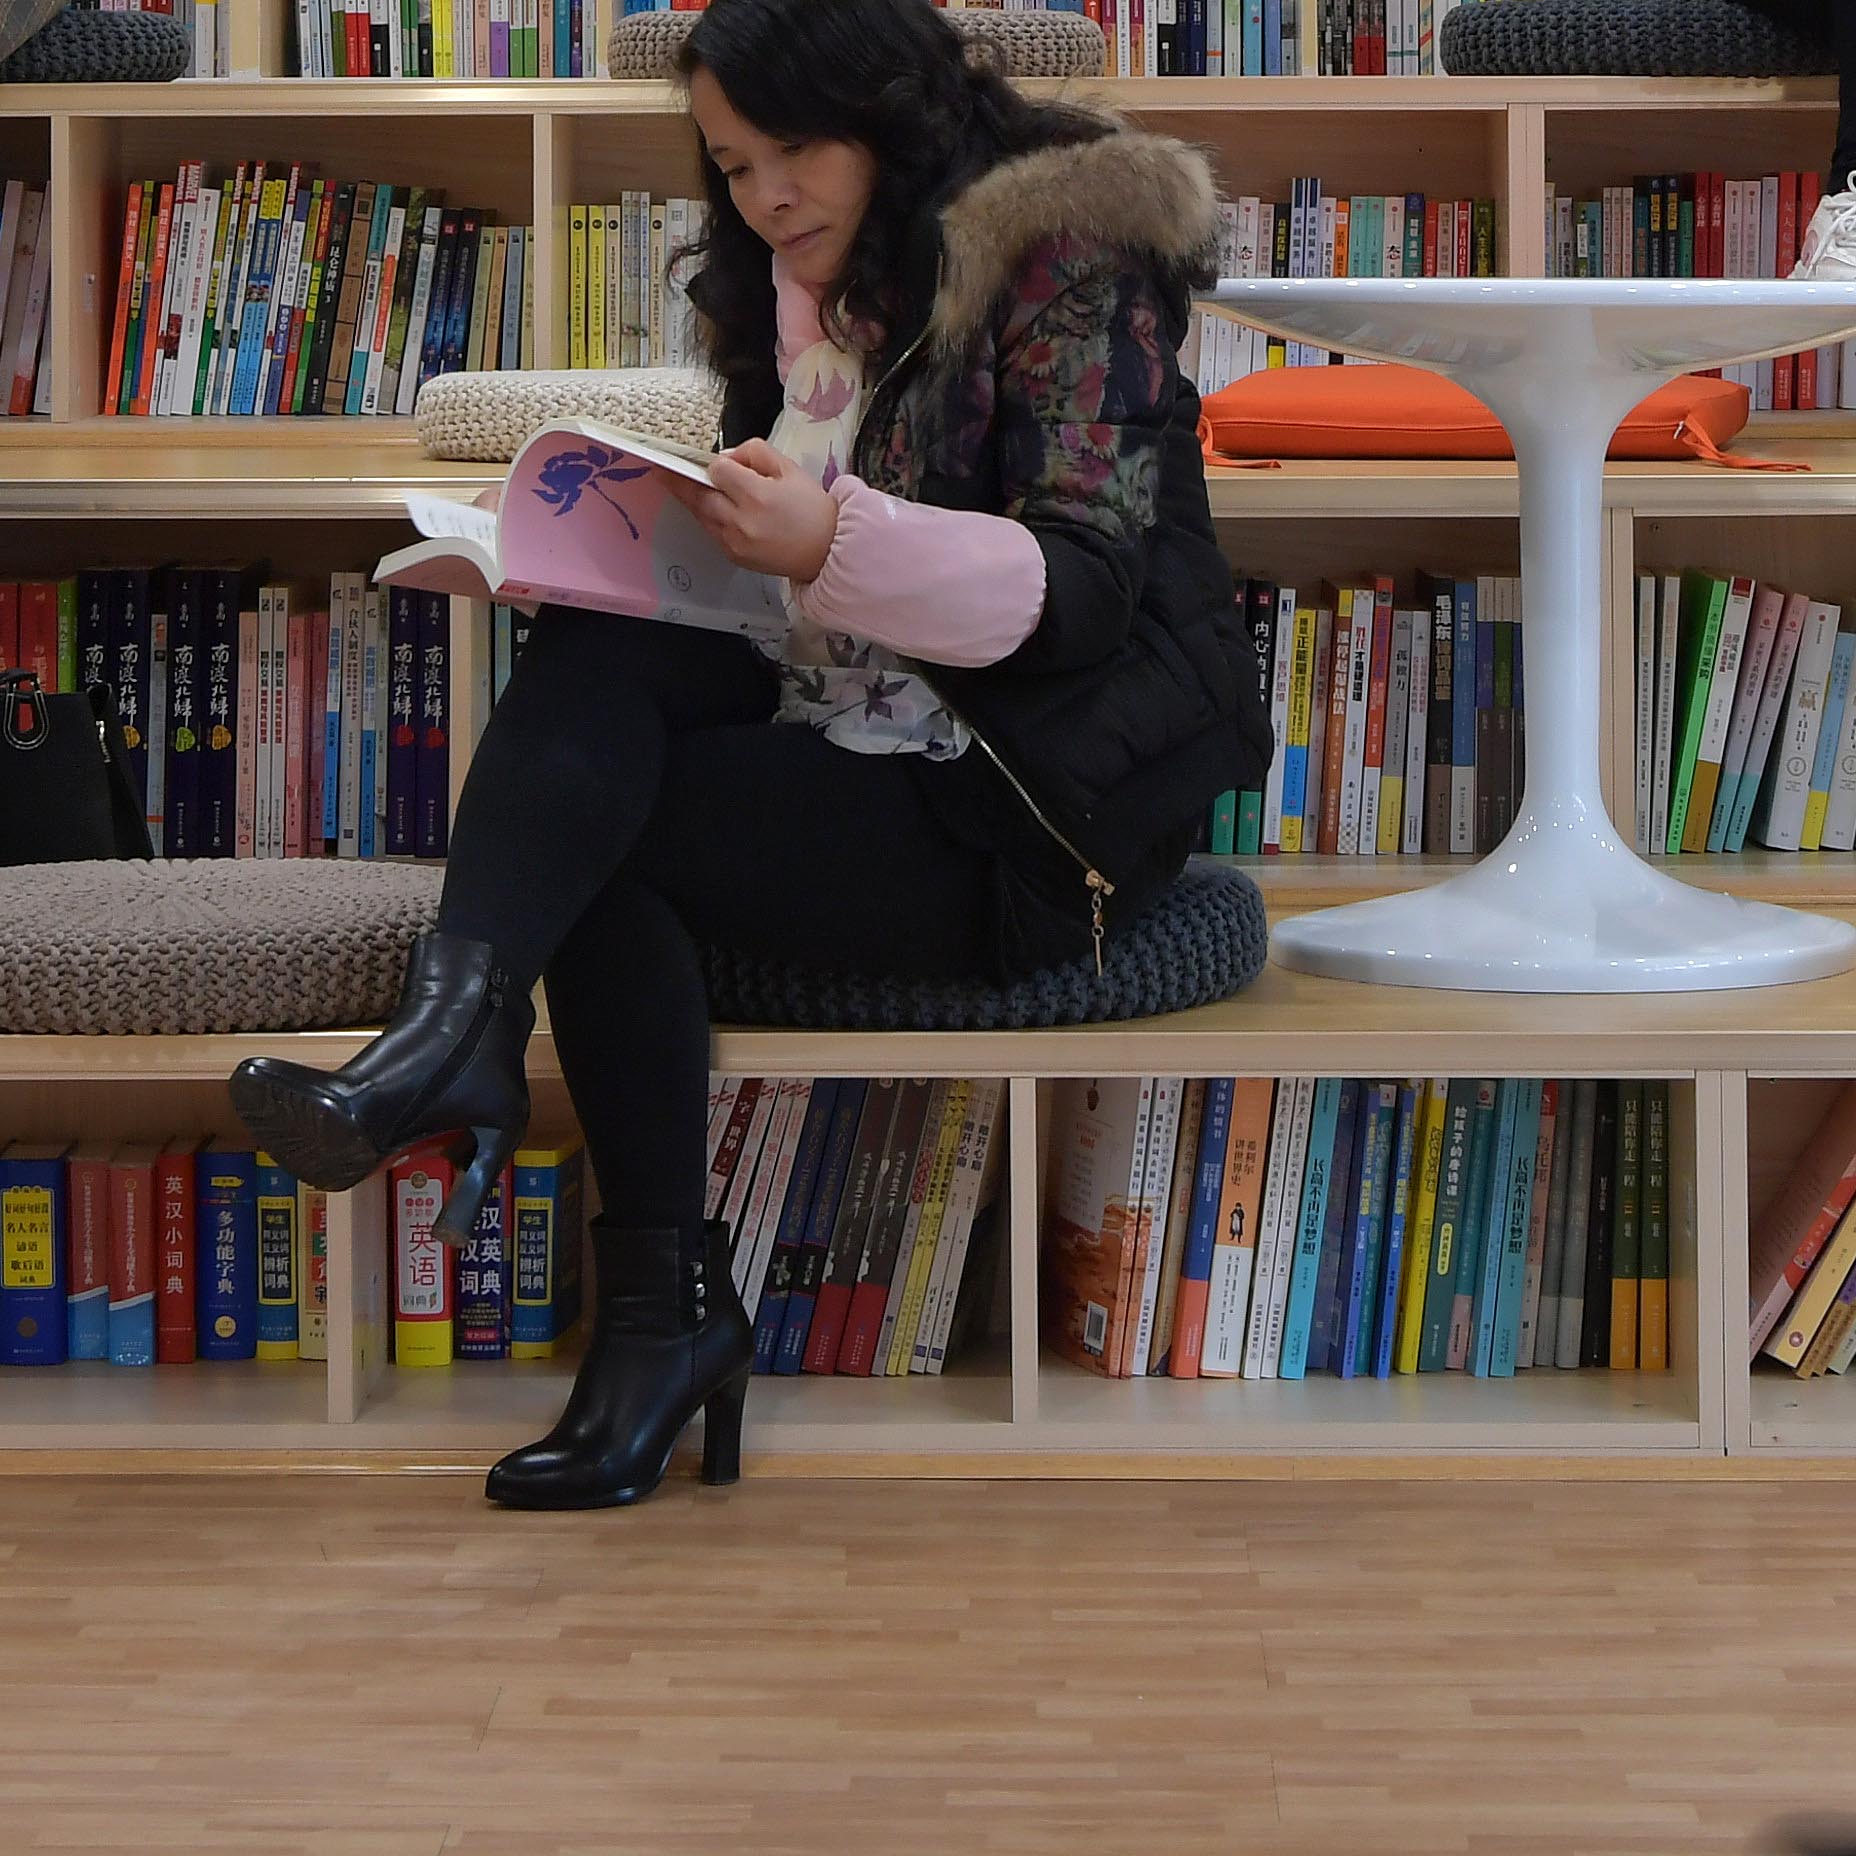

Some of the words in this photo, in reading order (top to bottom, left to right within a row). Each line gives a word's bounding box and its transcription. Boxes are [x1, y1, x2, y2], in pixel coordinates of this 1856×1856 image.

[1434, 594, 1453, 642] 毛泽东
[5, 1220, 50, 1234] 名人名言
[164, 1175, 185, 1296] 英汉小词典
[16, 1240, 38, 1253] 谚语
[215, 1210, 236, 1296] 多功能字典
[408, 1222, 438, 1288] 英语
[459, 1236, 502, 1265] 汉英
[10, 1257, 46, 1271] 歇后语
[262, 1273, 290, 1291] 词典
[458, 1268, 502, 1296] 词典
[518, 1274, 546, 1291] 词典
